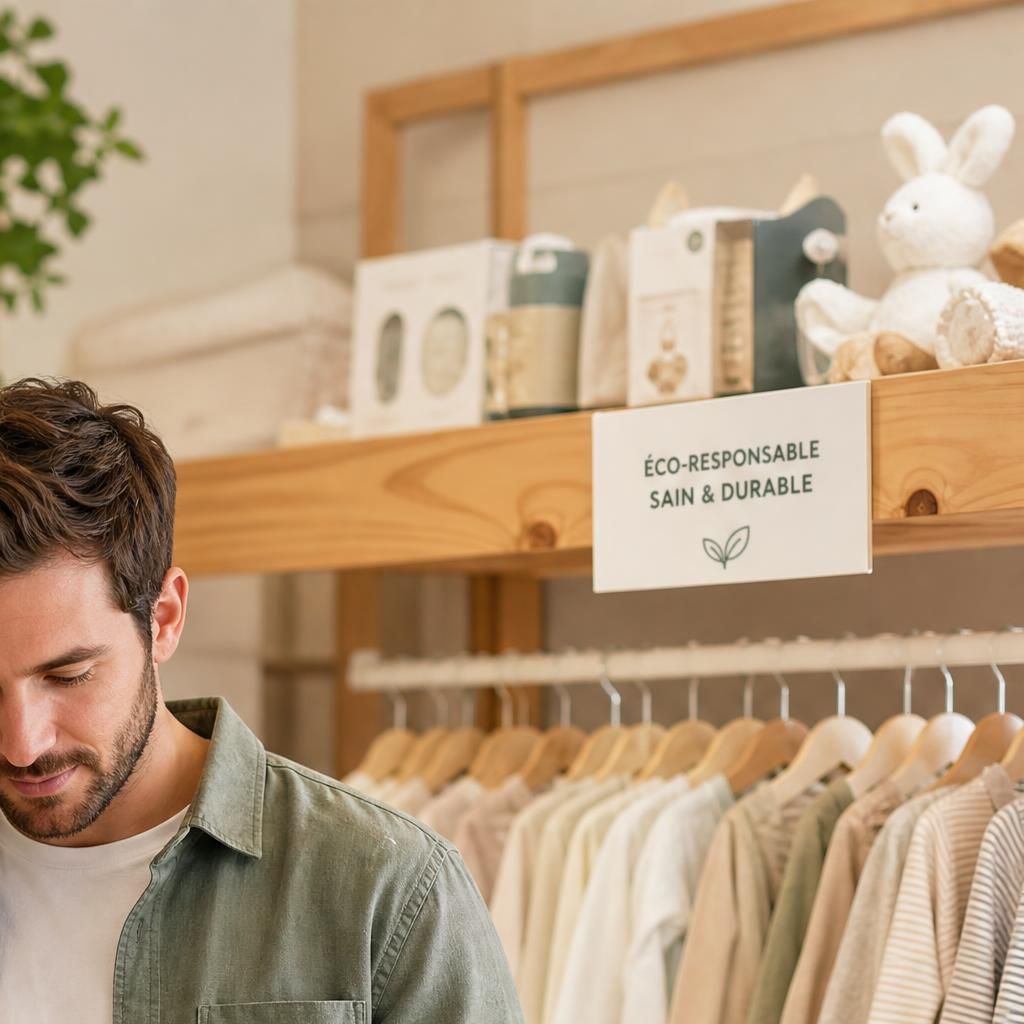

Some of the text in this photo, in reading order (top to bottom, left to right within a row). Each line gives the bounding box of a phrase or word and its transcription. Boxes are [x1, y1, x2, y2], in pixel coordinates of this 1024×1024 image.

[644, 439, 820, 477] ÉCO-RESPONSABLE
[650, 473, 813, 509] SAIN & DURABLE
